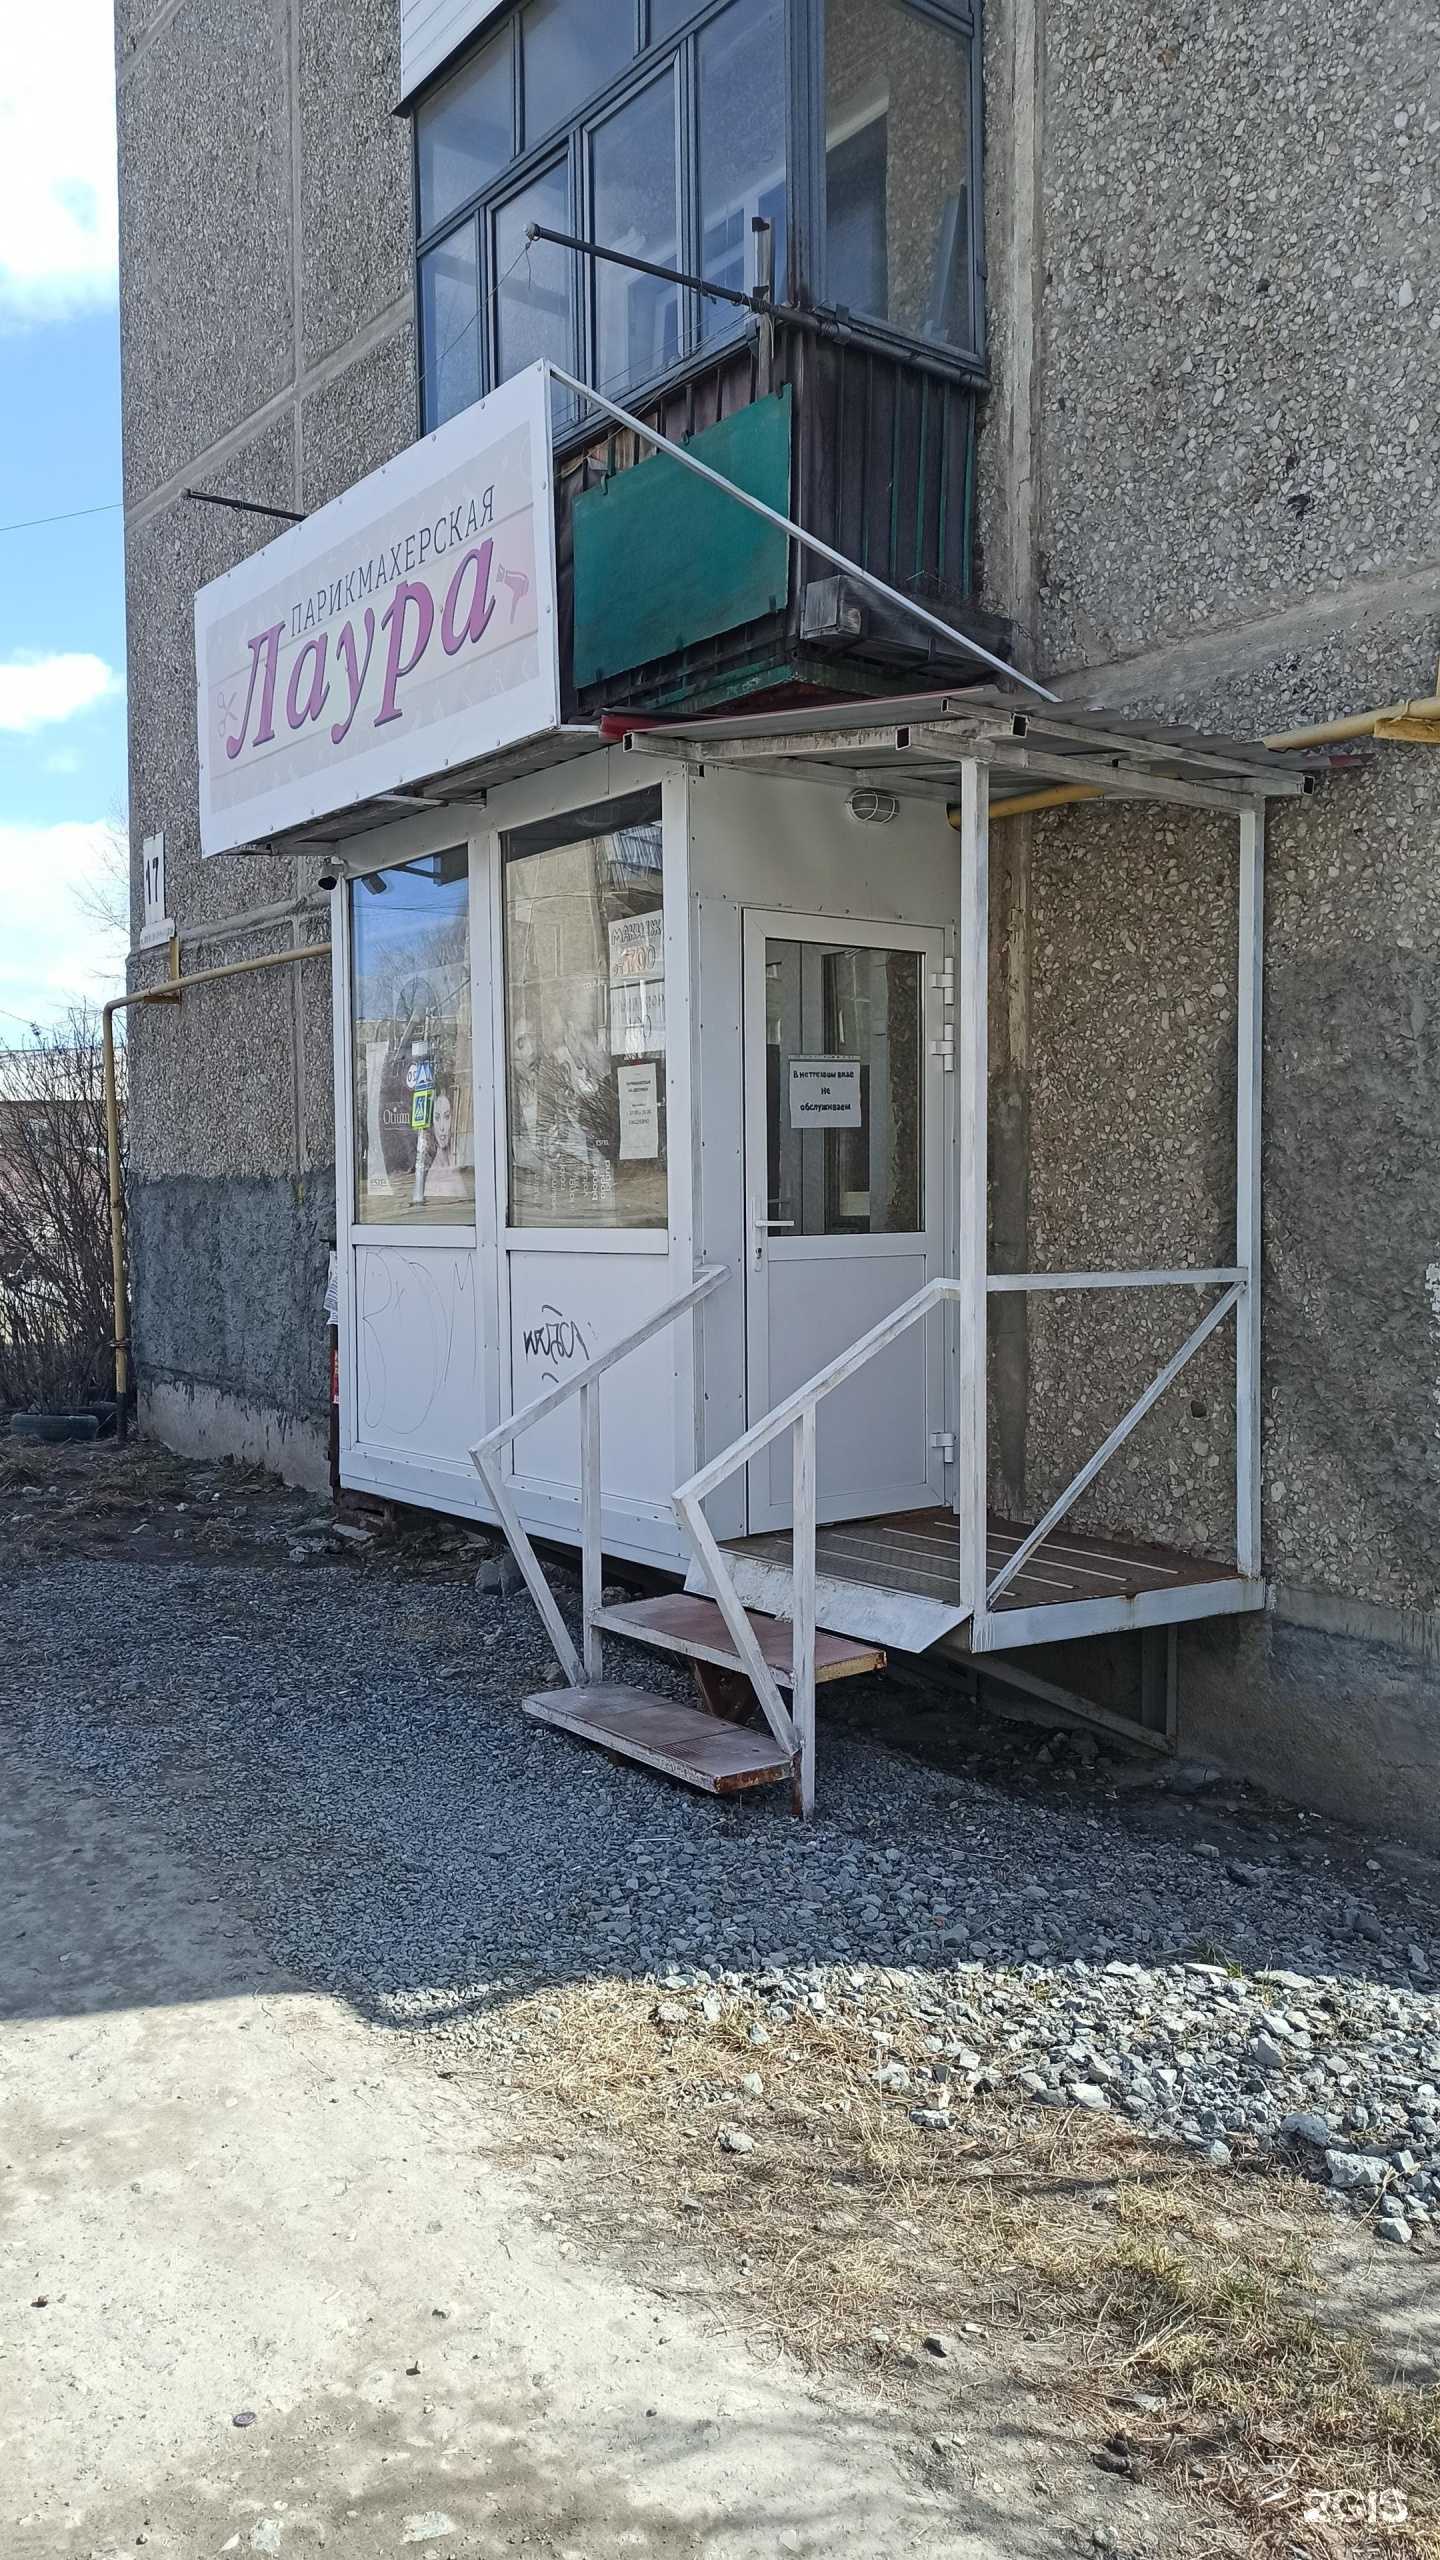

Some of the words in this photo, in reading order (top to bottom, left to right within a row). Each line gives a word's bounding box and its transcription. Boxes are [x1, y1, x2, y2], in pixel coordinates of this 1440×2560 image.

[291, 485, 495, 637] ПАРИКМАХЕРСКАЯ
[226, 537, 496, 760] Лаура
[145, 856, 159, 905] 17
[800, 1102, 851, 1112] обслуживаем
[821, 1087, 831, 1095] не
